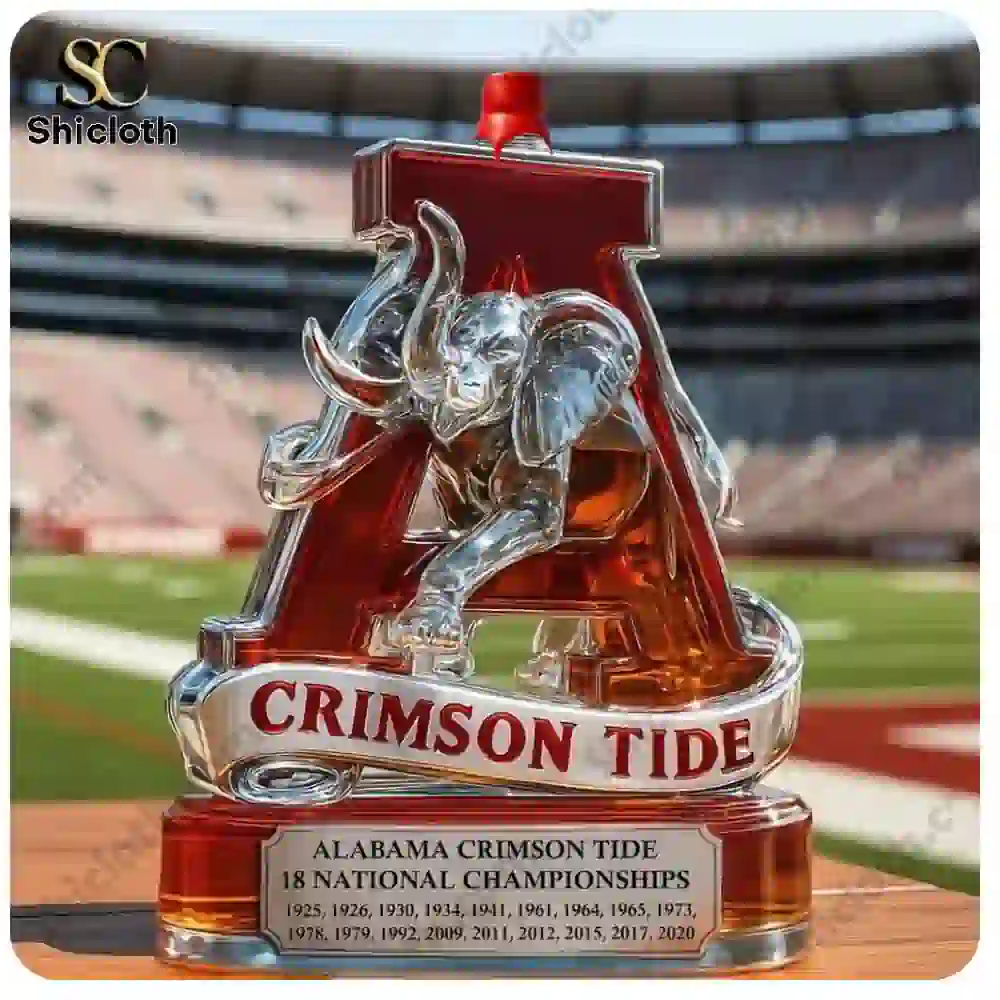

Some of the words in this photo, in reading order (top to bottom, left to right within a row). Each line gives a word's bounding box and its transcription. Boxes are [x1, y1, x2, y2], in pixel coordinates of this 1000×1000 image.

[249, 680, 578, 774] CRIMSON
[602, 718, 756, 780] TIDE
[312, 839, 450, 860] ALABAMA
[457, 839, 586, 860] CRIMSON
[593, 839, 659, 860] TIDE
[283, 869, 306, 890] 18
[313, 869, 455, 890] NATIONAL
[463, 869, 691, 890] CHAMPIONSHIPS
[286, 902, 327, 920] 1925,
[332, 902, 373, 920] 1926,
[378, 902, 419, 920] 1930,
[424, 902, 466, 920] 1934,
[470, 902, 512, 920] 1941,
[517, 902, 558, 920] 1961,
[564, 902, 605, 920] 1964,
[610, 902, 651, 920] 1965,
[656, 902, 697, 920] 1973,
[288, 925, 329, 943] 1978,
[334, 925, 375, 943] 1979,
[381, 925, 421, 943] 1992,
[425, 925, 467, 943] 2009,
[471, 925, 514, 943] 2011,
[517, 925, 560, 943] 2012,
[565, 925, 606, 943] 2015,
[611, 925, 653, 943] 2017,
[657, 925, 696, 943] 2020
